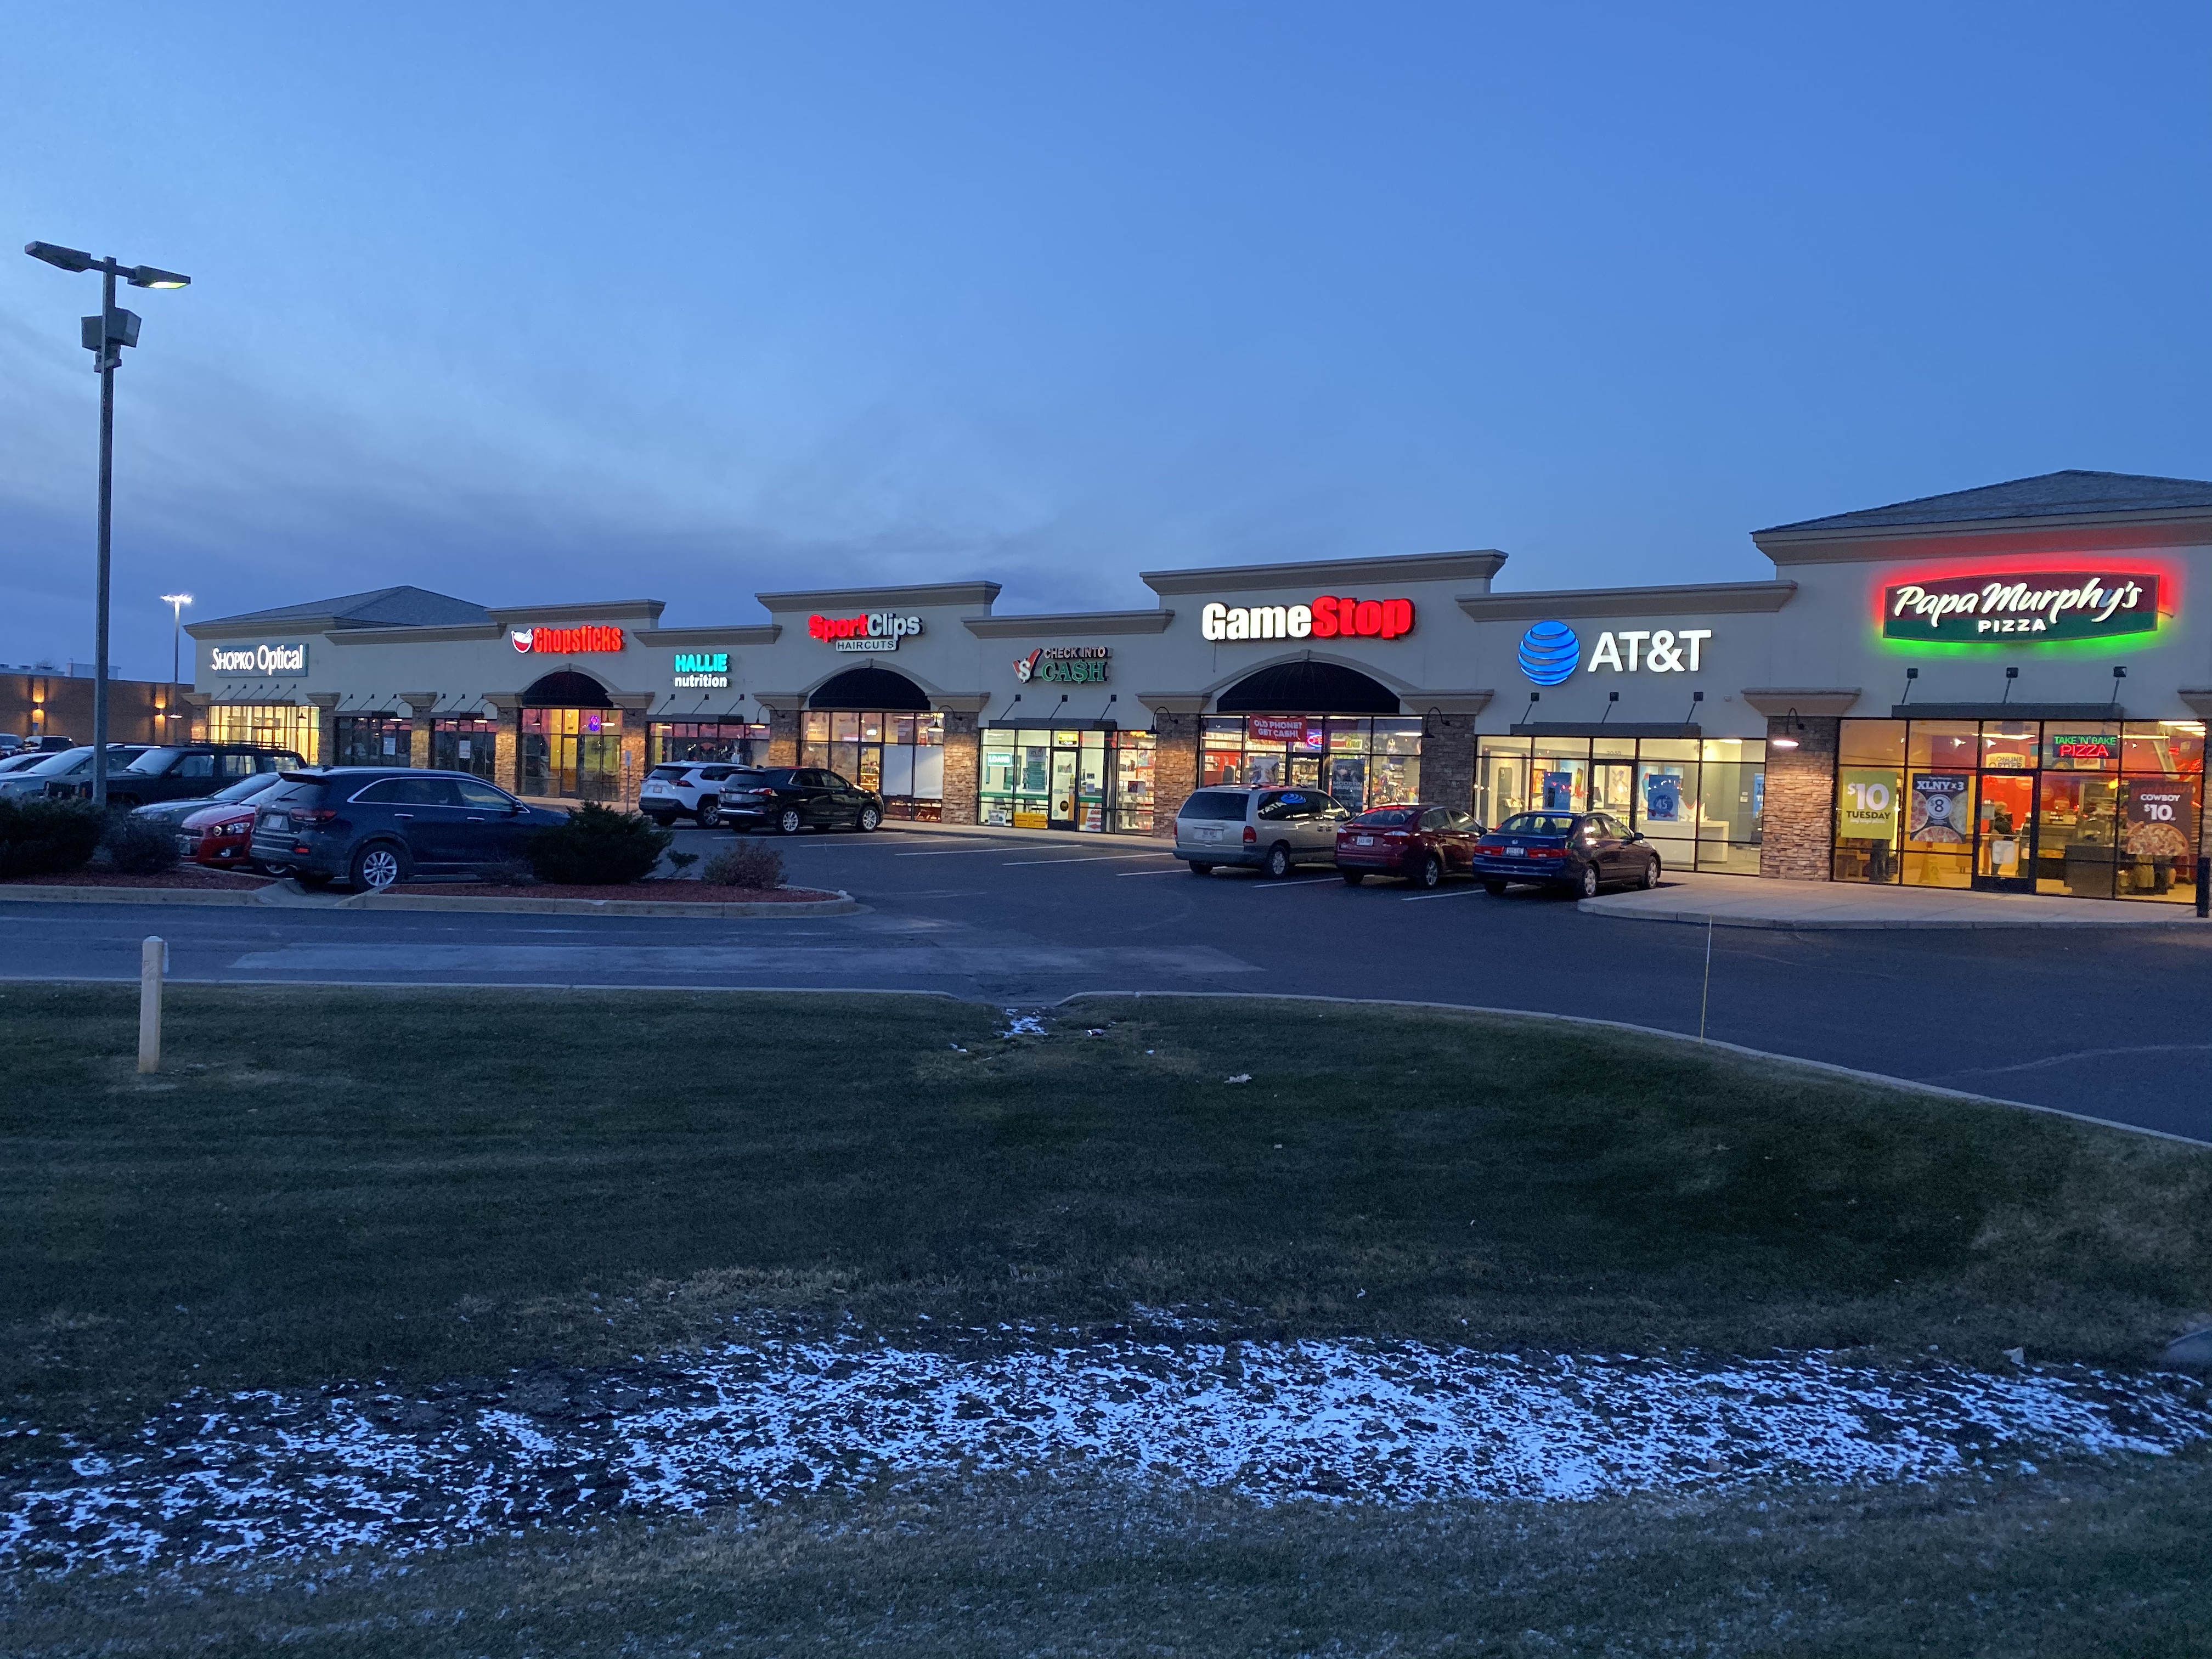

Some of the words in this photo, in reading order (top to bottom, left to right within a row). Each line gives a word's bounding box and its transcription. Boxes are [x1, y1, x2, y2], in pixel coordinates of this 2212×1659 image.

[1893, 585, 1979, 628] Papa
[1980, 577, 2143, 624] Murphy's
[1202, 595, 1415, 641] GameStop
[1977, 618, 2047, 633] PIZZA
[533, 625, 623, 654] Chopsticks
[837, 640, 894, 650] HAIRCUTS
[1043, 647, 1079, 659] CHECK
[1080, 646, 1107, 658] INTO
[1587, 629, 1713, 673] AT&T
[212, 647, 255, 671] SHOPKO
[257, 644, 303, 676] Optical
[675, 653, 728, 673] HALLIE
[674, 674, 728, 688] nutrition
[1254, 719, 1268, 728] OLD
[1269, 721, 1302, 730] PHONE?
[1273, 729, 1299, 738] CASH!
[2054, 736, 2077, 744] TAKE
[2092, 737, 2117, 746] BAKE
[2060, 744, 2109, 757] PIZZA
[1847, 781, 1889, 811] $10
[1846, 810, 1892, 820] TUESDAY
[2144, 804, 2173, 821] $10
